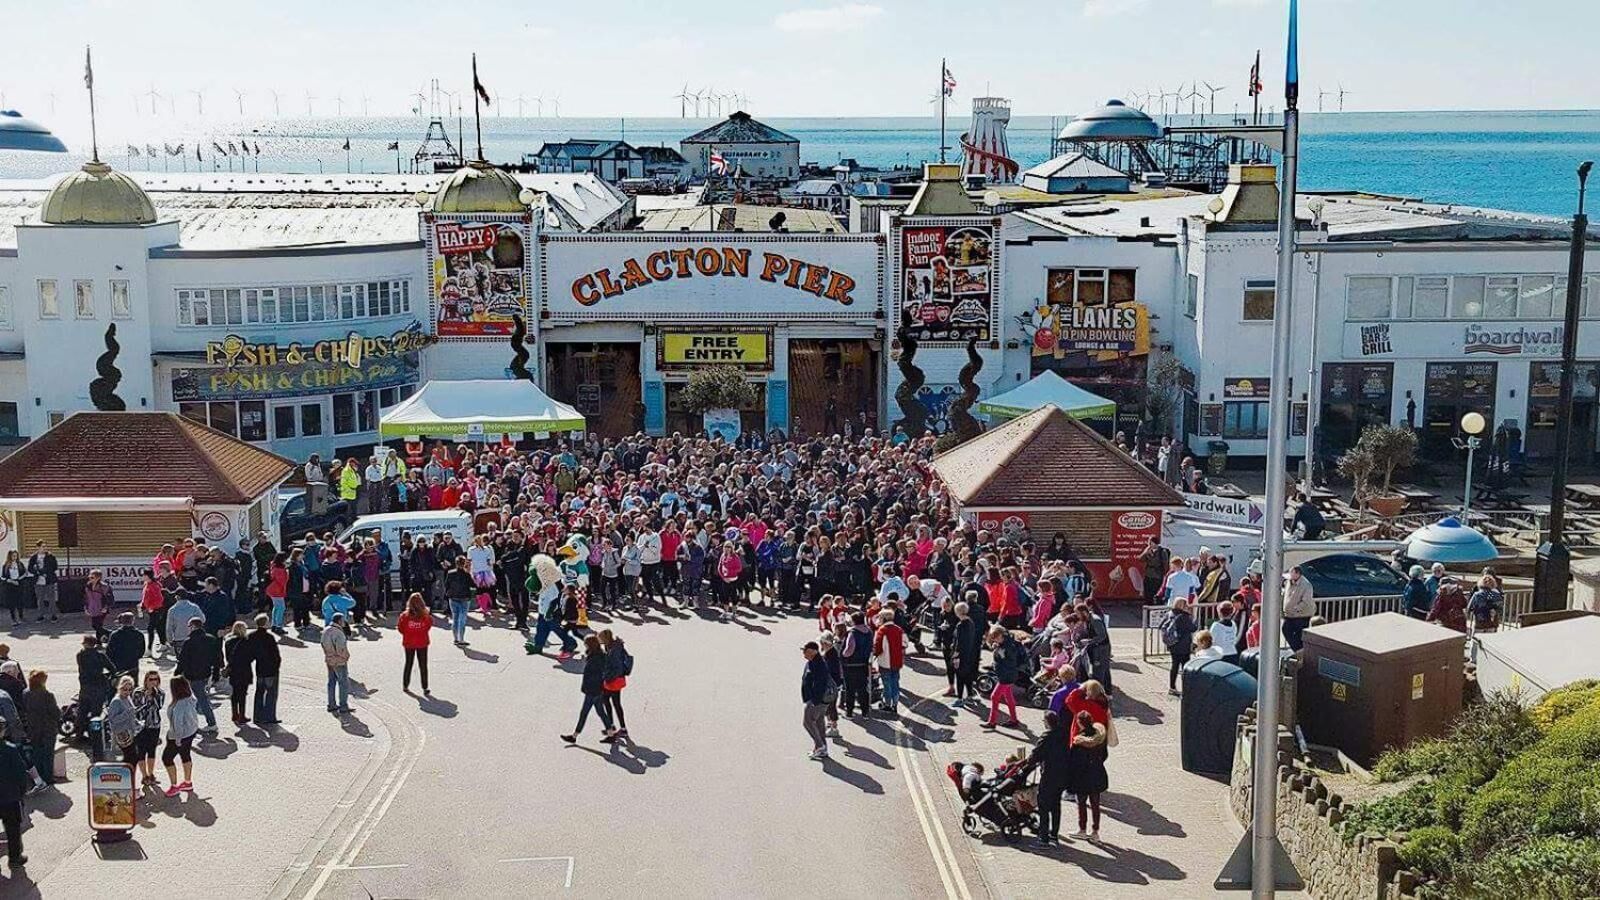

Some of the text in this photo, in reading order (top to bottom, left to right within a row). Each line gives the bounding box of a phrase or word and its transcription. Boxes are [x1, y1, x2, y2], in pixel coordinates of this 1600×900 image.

[438, 229, 485, 248] HAPPY
[906, 231, 941, 244] Indoor
[908, 241, 943, 255] Family
[908, 254, 929, 265] Fun
[571, 247, 857, 307] CLACTON PIER
[1060, 306, 1137, 330] THE LANES
[1070, 329, 1088, 340] PIN
[1089, 329, 1136, 341] BOWLING
[1360, 323, 1390, 335] family
[692, 336, 738, 348] FREE
[1361, 332, 1380, 344] BAR
[285, 340, 307, 365] &
[313, 332, 389, 369] CHIPS
[1362, 341, 1393, 355] GRILL
[684, 349, 746, 361] ENTRY
[1184, 499, 1246, 516] oardwalk
